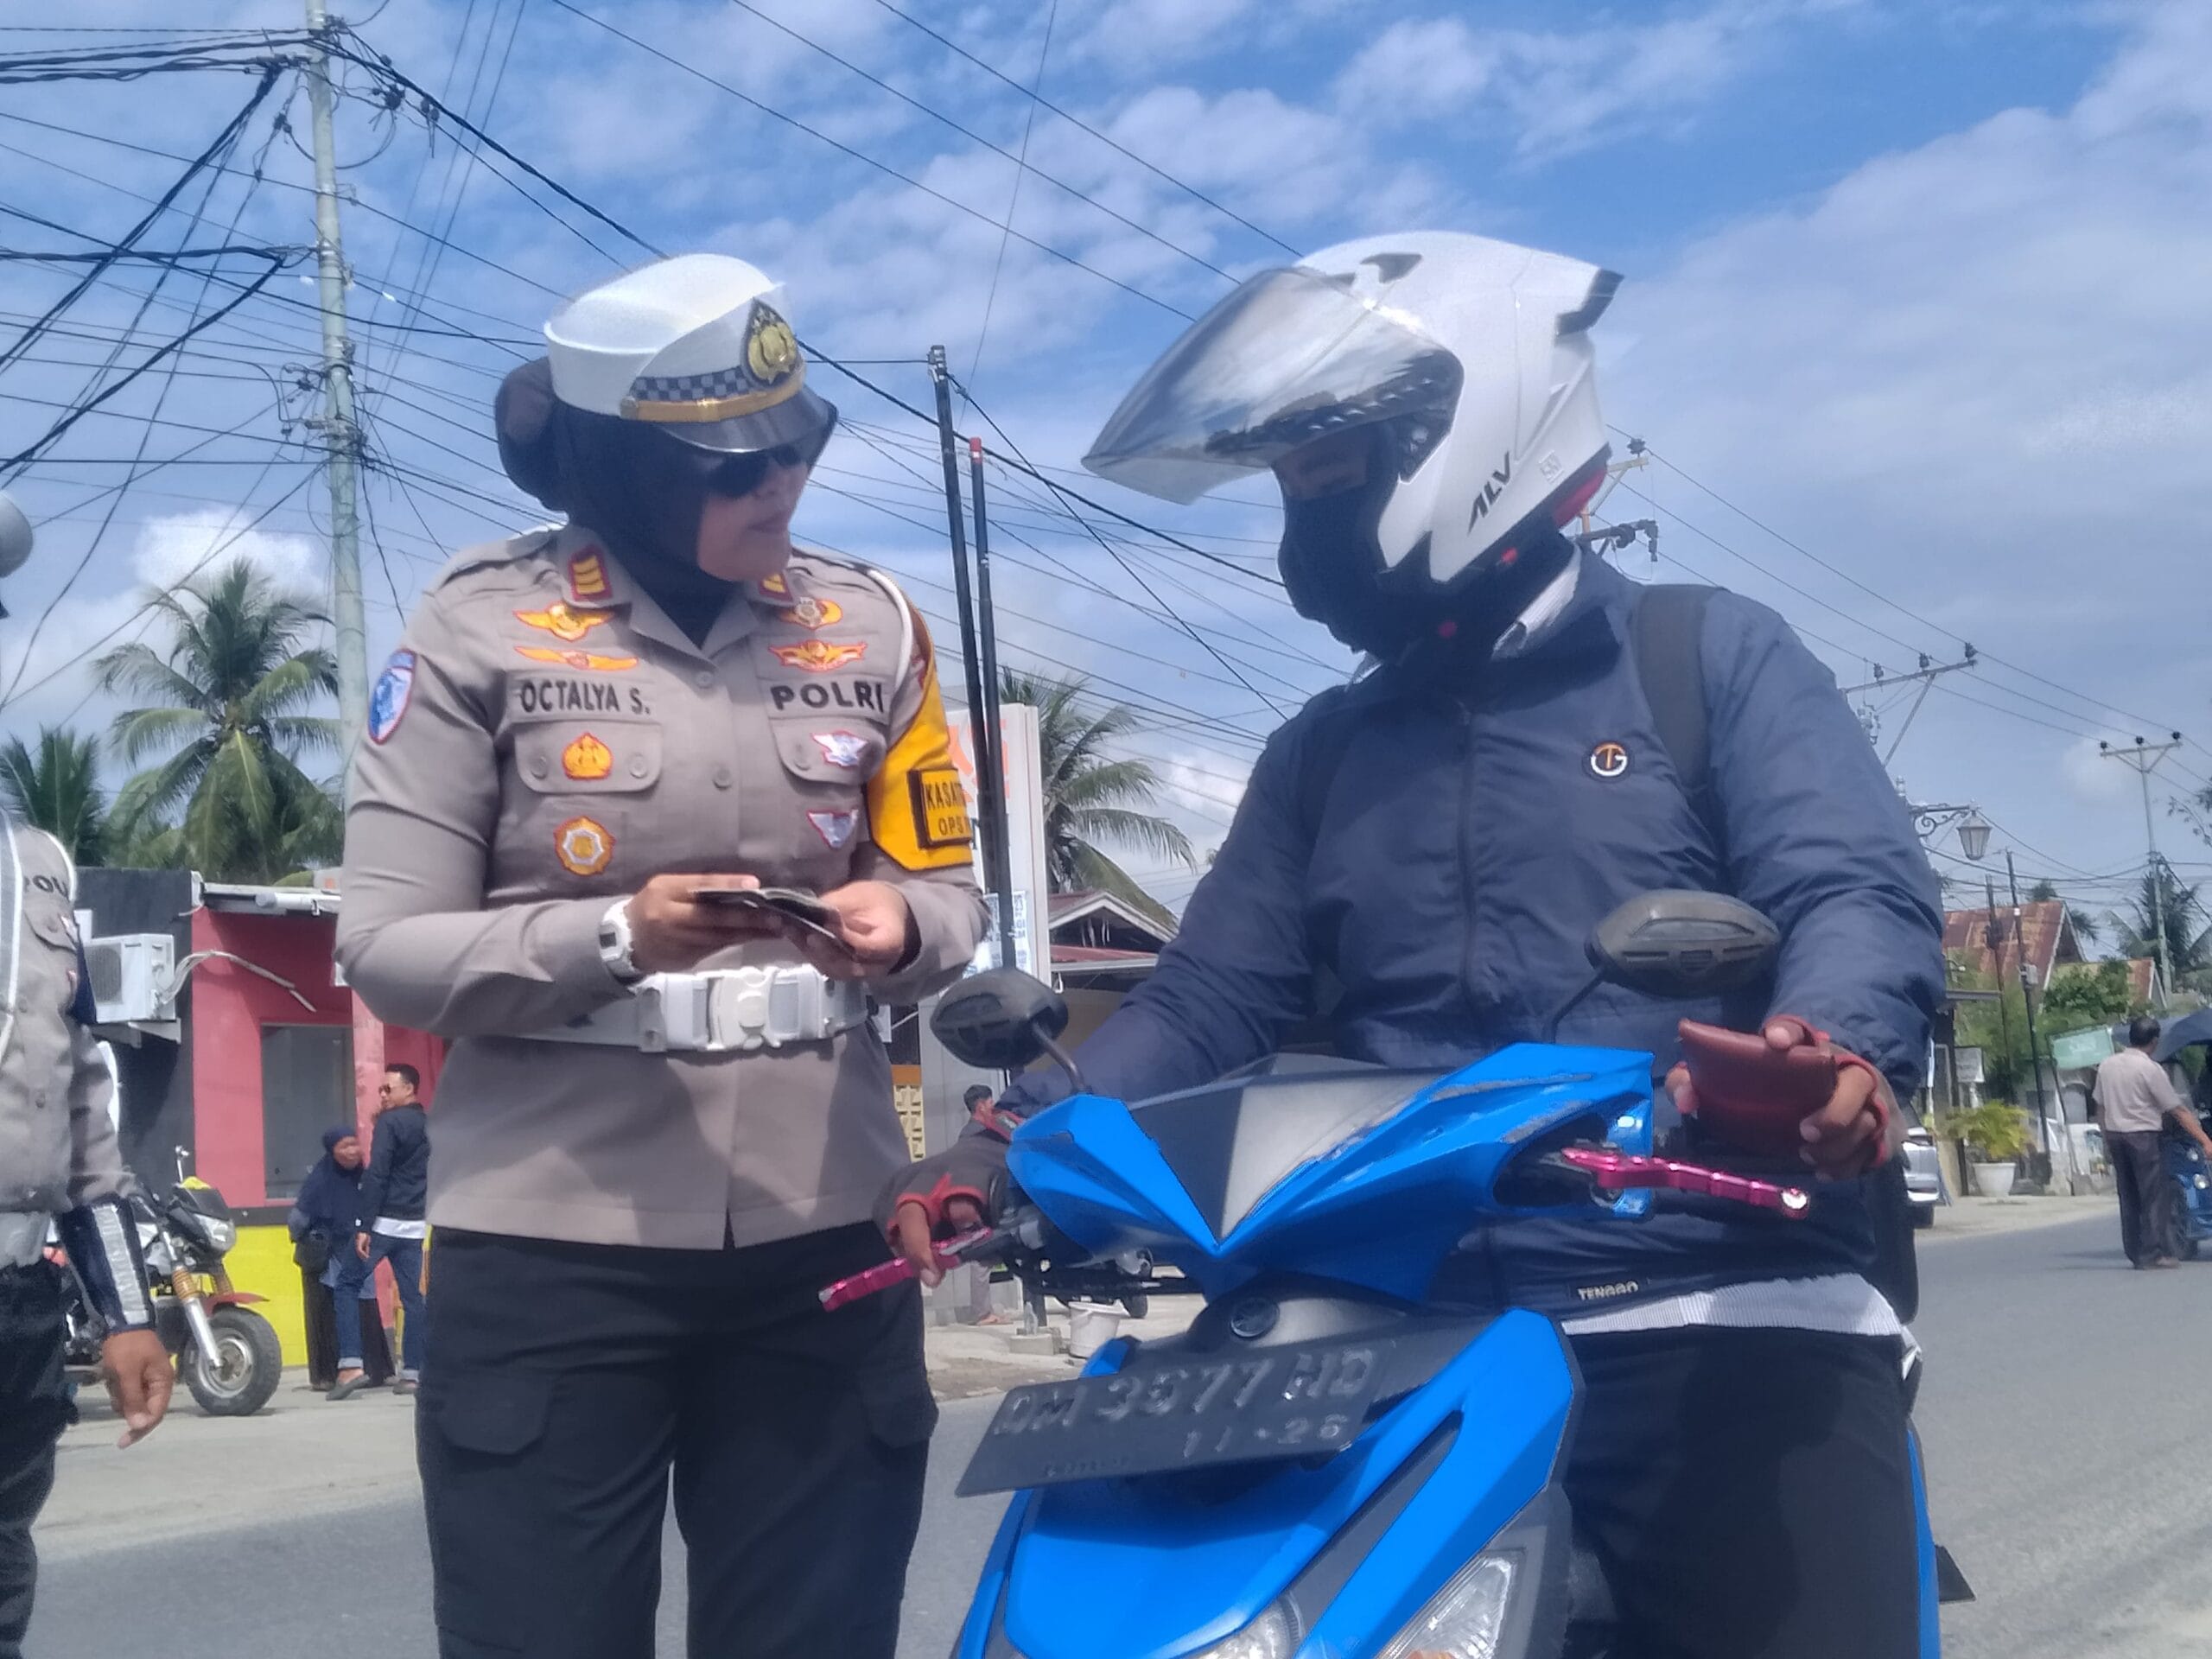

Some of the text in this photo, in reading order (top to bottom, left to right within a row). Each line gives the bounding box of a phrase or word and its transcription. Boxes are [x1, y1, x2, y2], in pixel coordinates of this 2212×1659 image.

[520, 680, 651, 715] OCTALYA S.
[770, 681, 883, 713] POLRI
